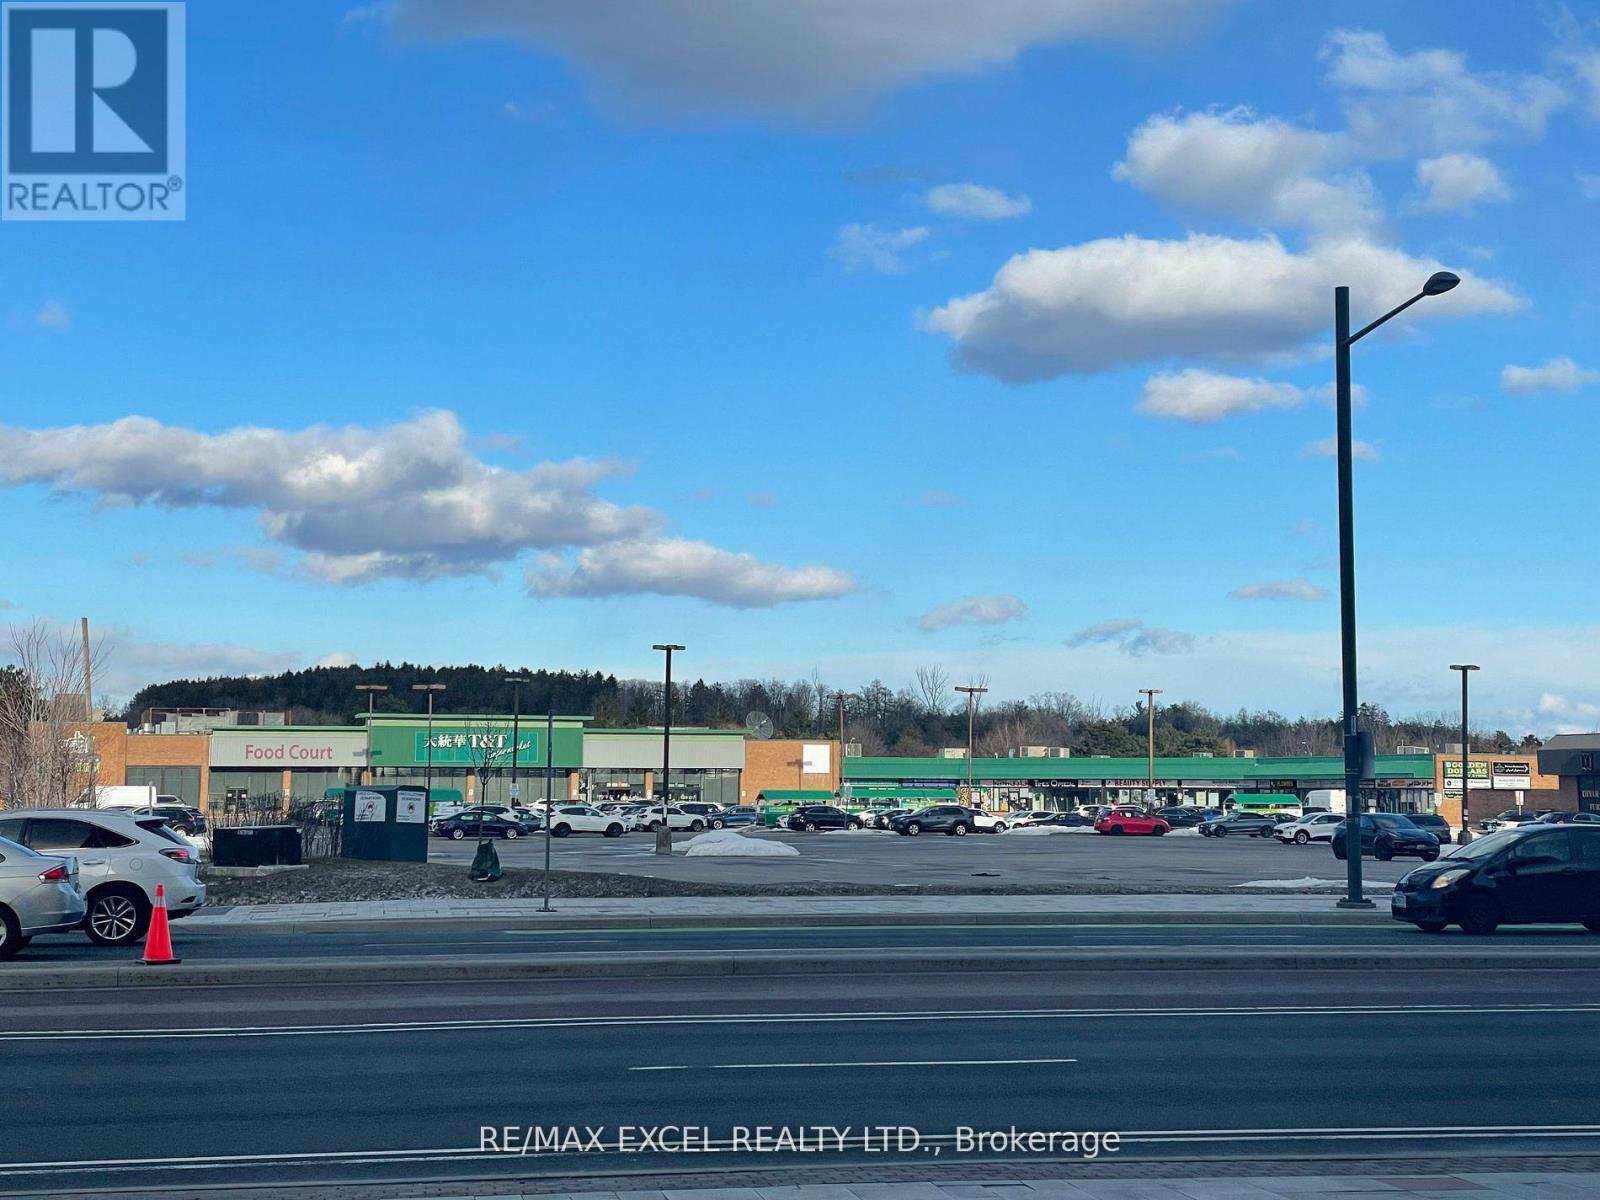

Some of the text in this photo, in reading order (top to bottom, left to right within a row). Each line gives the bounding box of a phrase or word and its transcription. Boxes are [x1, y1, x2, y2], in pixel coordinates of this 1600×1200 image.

[468, 734, 508, 749] T&T
[245, 744, 333, 760] Food Court
